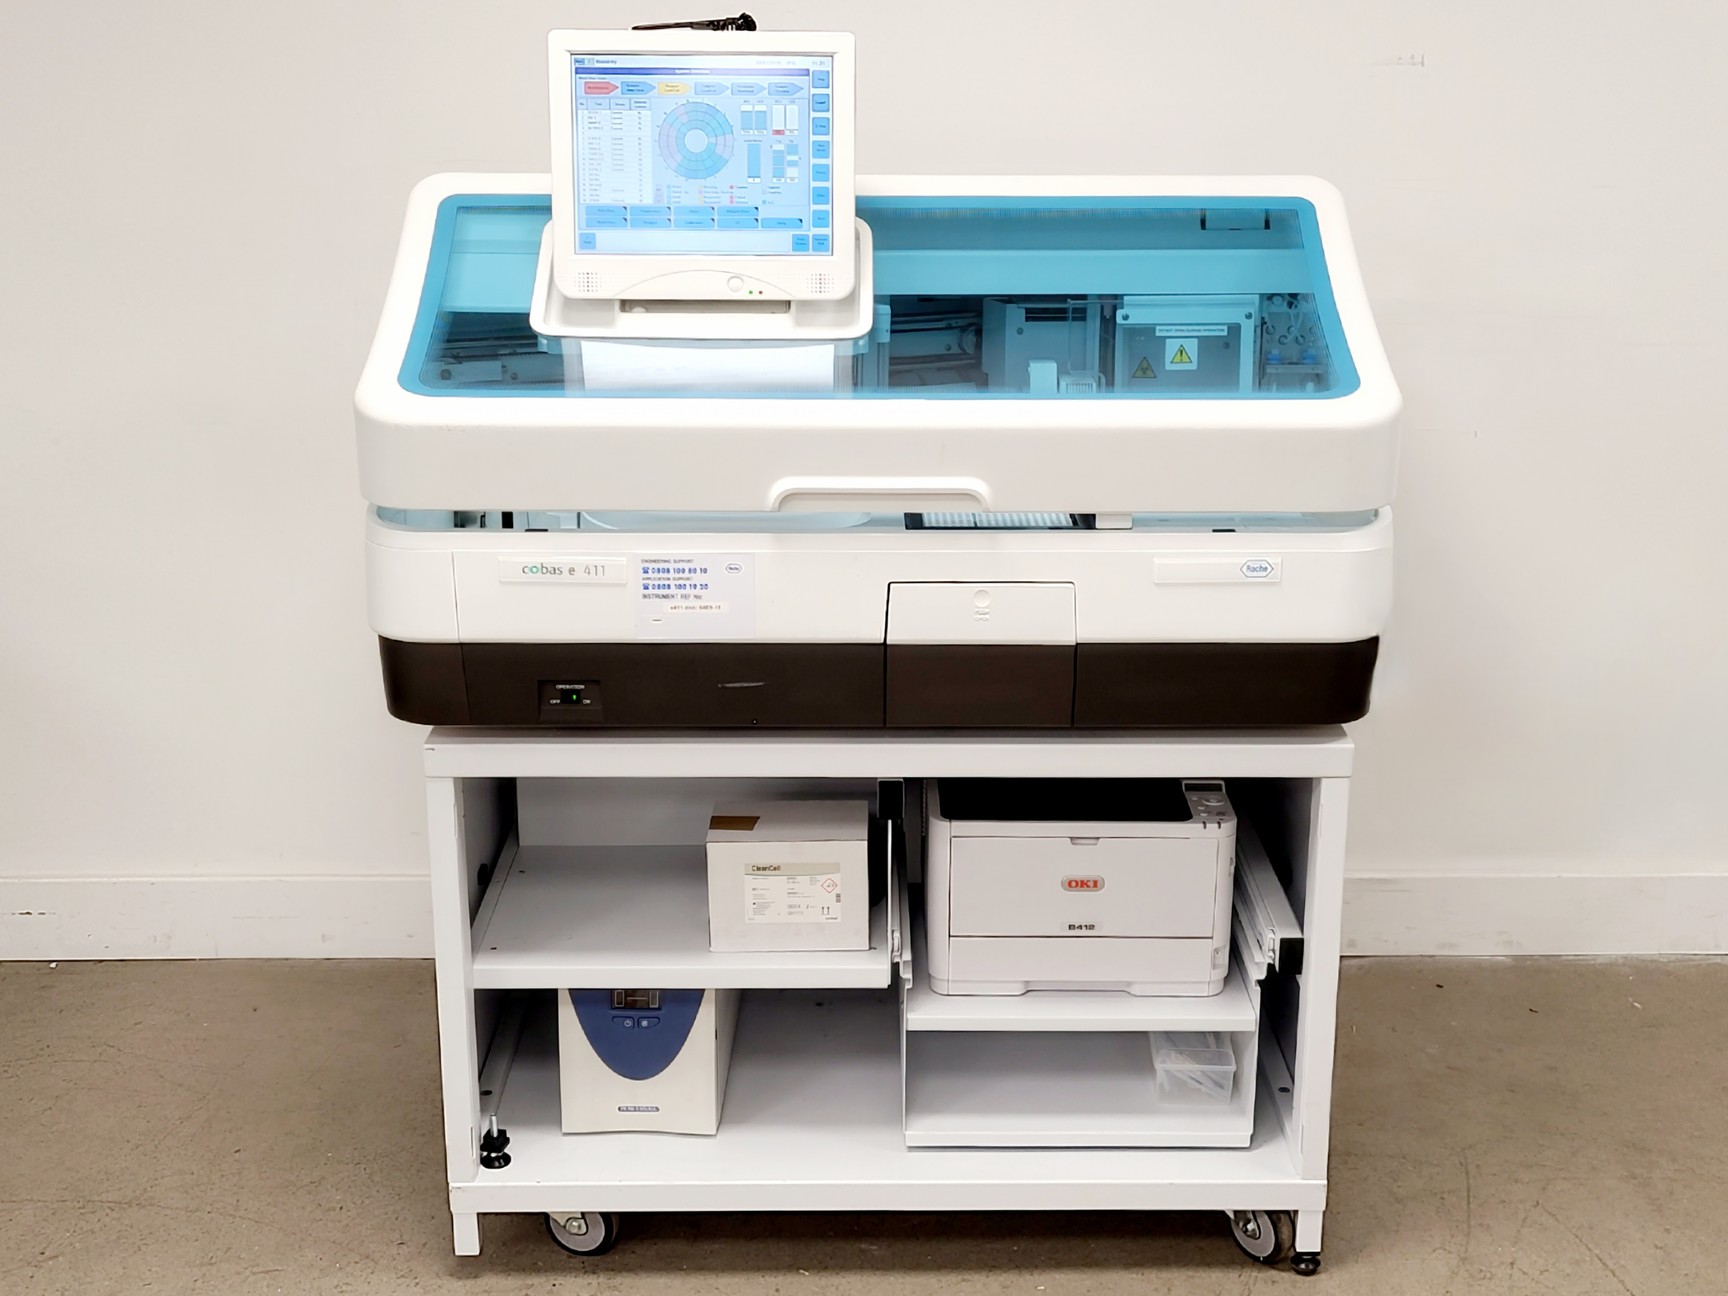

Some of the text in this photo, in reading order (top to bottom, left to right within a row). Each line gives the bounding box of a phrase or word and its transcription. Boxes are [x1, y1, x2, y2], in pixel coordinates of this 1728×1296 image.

[522, 562, 606, 577] cobas e 411
[1246, 564, 1269, 573] Roche
[1067, 879, 1099, 889] OKI
